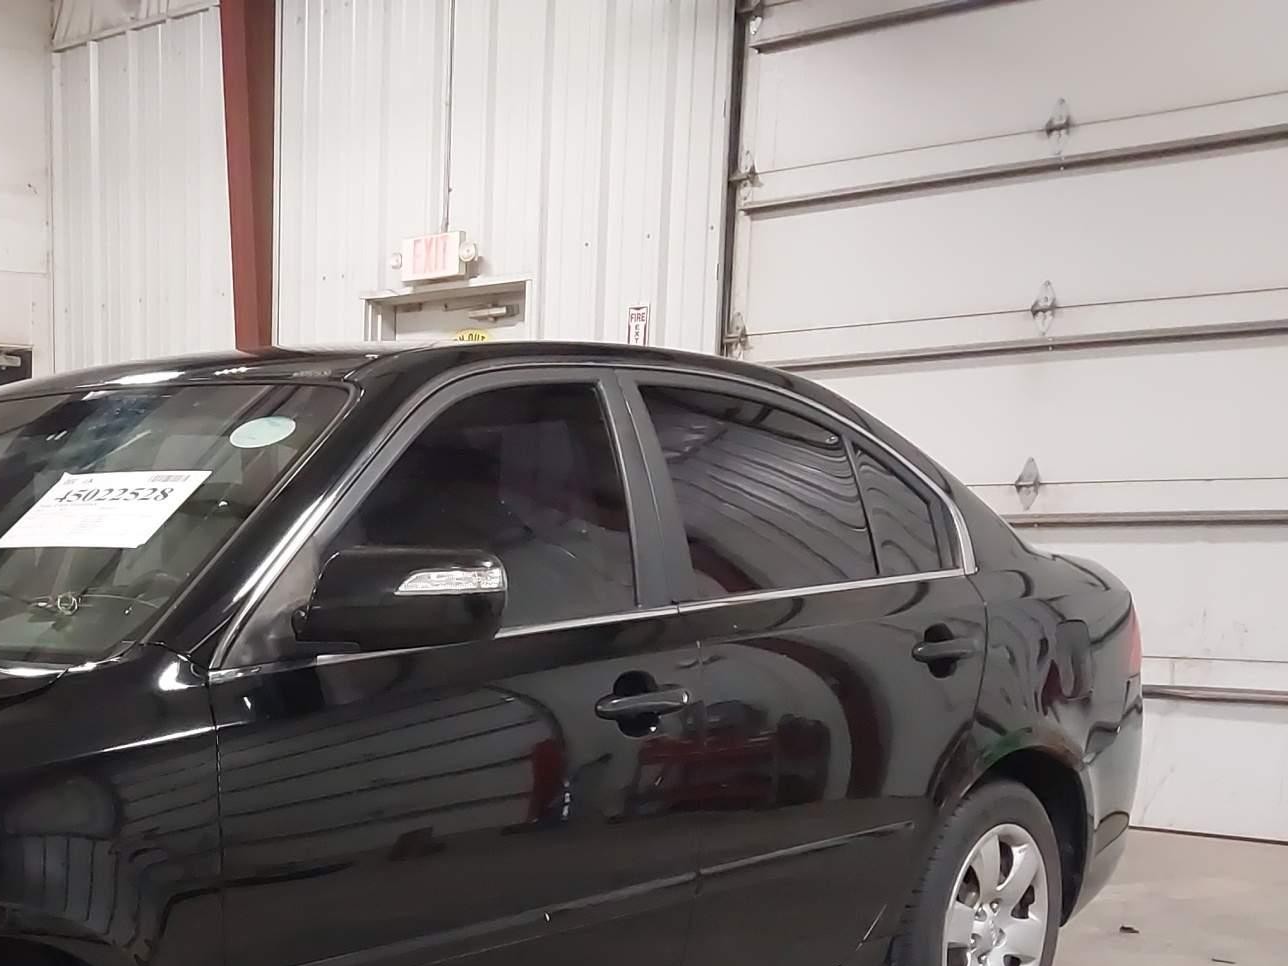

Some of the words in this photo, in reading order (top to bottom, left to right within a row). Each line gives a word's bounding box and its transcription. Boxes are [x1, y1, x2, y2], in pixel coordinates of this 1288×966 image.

[413, 234, 448, 274] EXIT
[630, 312, 645, 322] FIRE
[55, 487, 174, 503] 45022528
